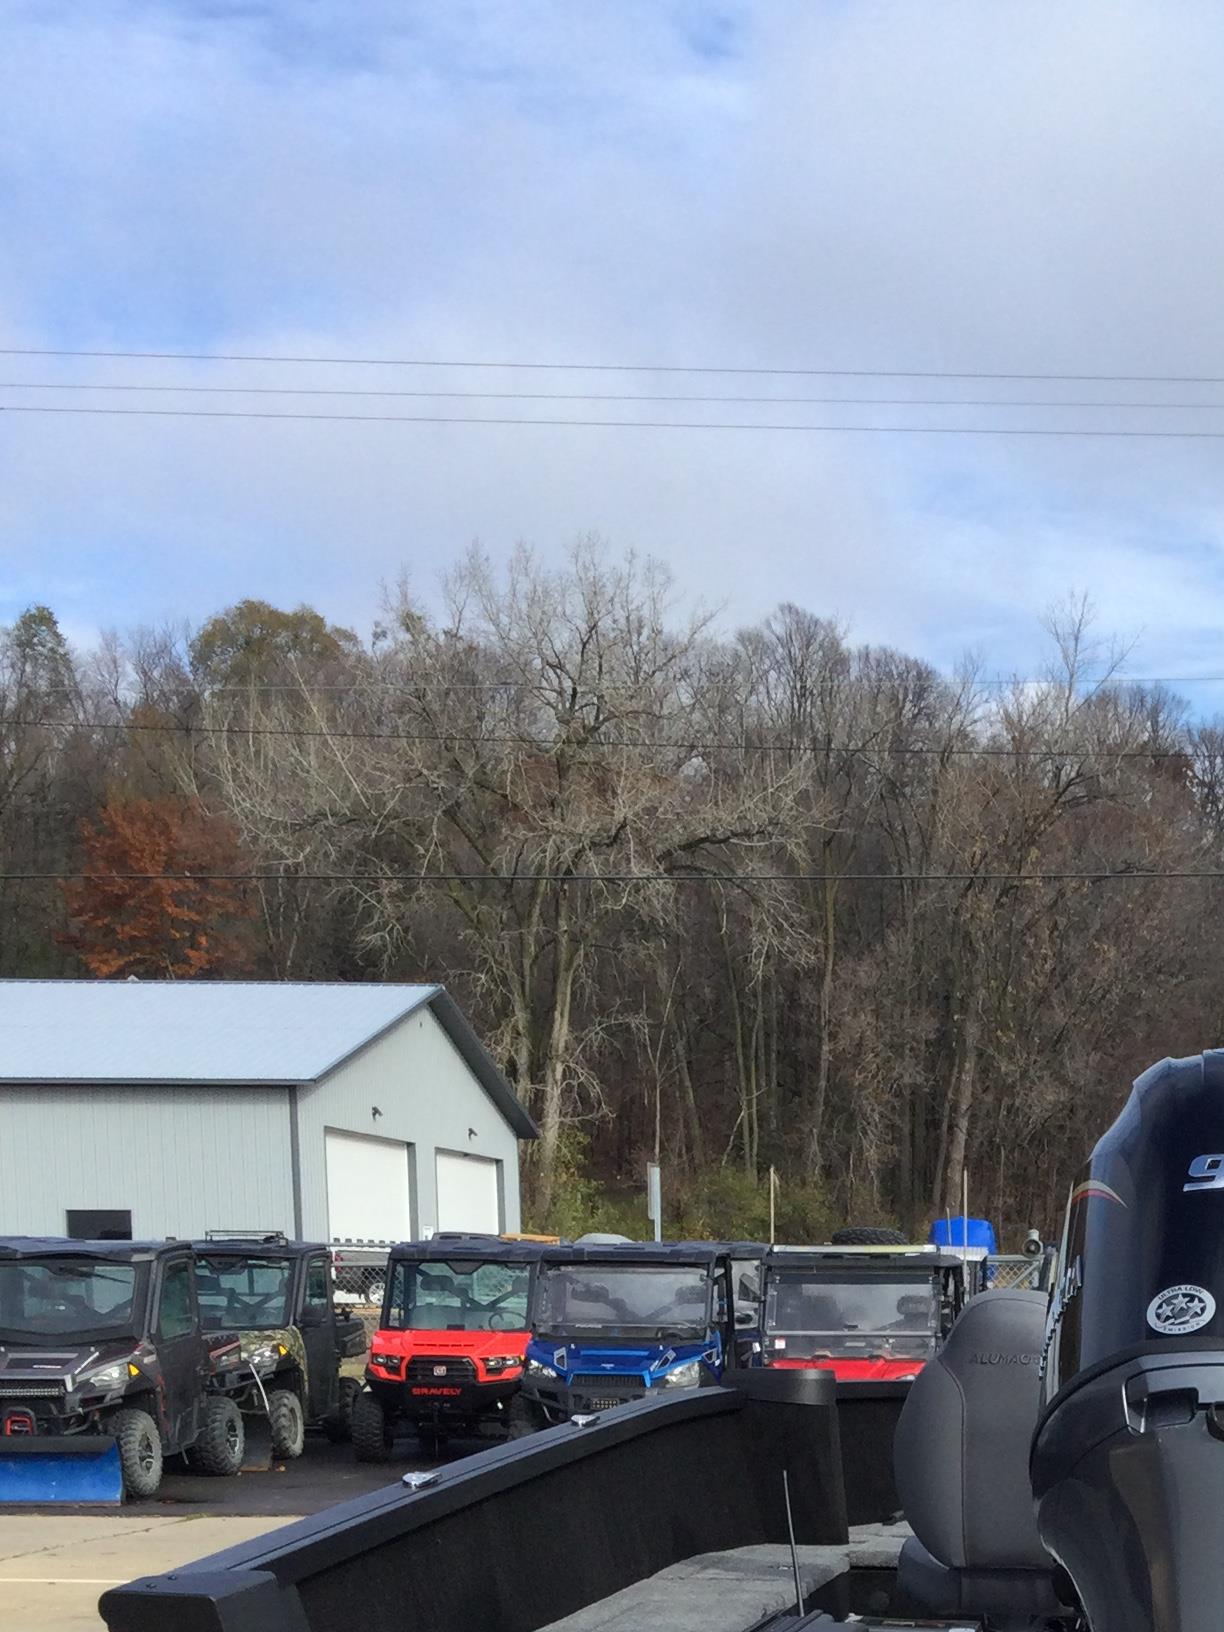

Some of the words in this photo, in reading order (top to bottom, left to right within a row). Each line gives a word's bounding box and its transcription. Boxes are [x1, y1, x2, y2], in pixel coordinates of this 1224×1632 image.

[1158, 1286, 1183, 1300] ULTRA
[1185, 1286, 1204, 1295] LOW
[412, 1387, 461, 1396] GRAVELY
